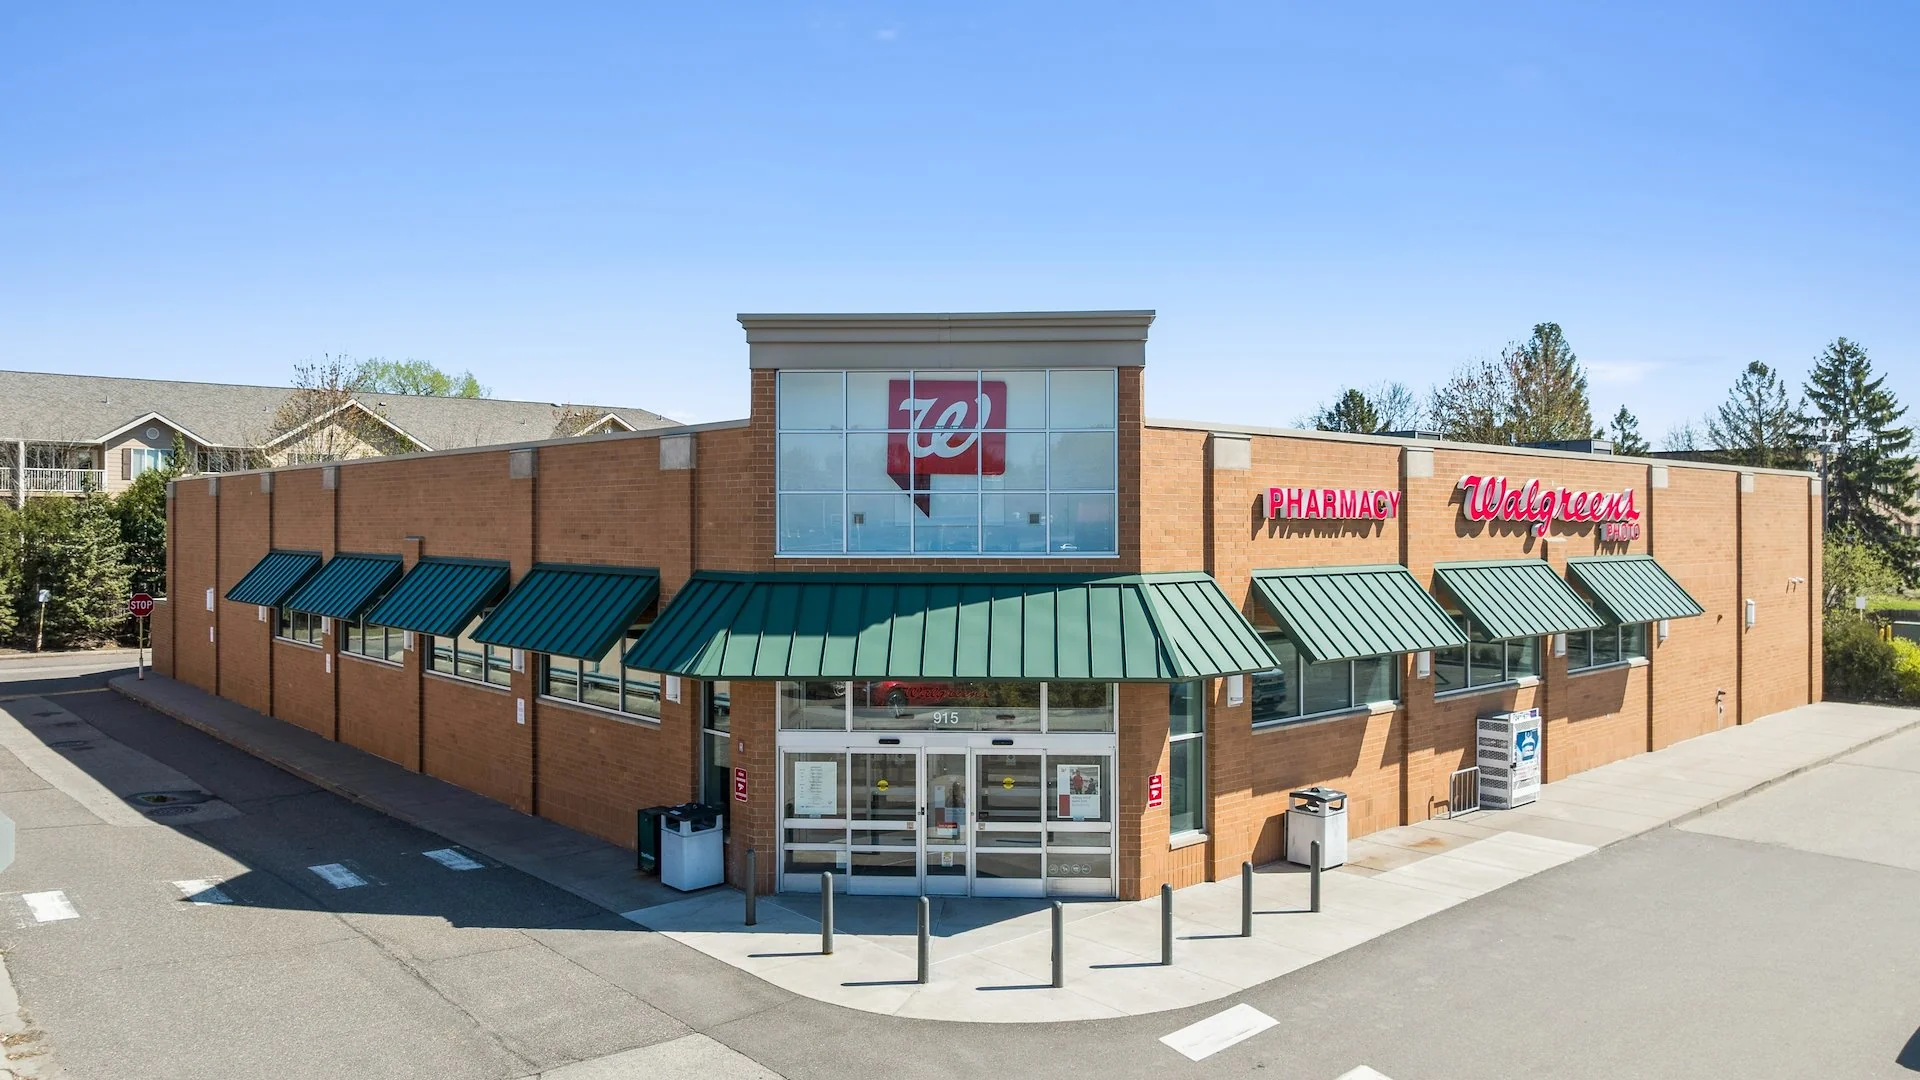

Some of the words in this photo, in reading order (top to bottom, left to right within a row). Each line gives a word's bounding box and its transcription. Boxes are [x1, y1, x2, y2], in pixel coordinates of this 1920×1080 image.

[1269, 487, 1401, 519] PHARMACY
[1463, 475, 1640, 537] Walgreens
[1606, 522, 1640, 541] PHOTO
[130, 600, 153, 610] STOP
[933, 712, 959, 724] 915
